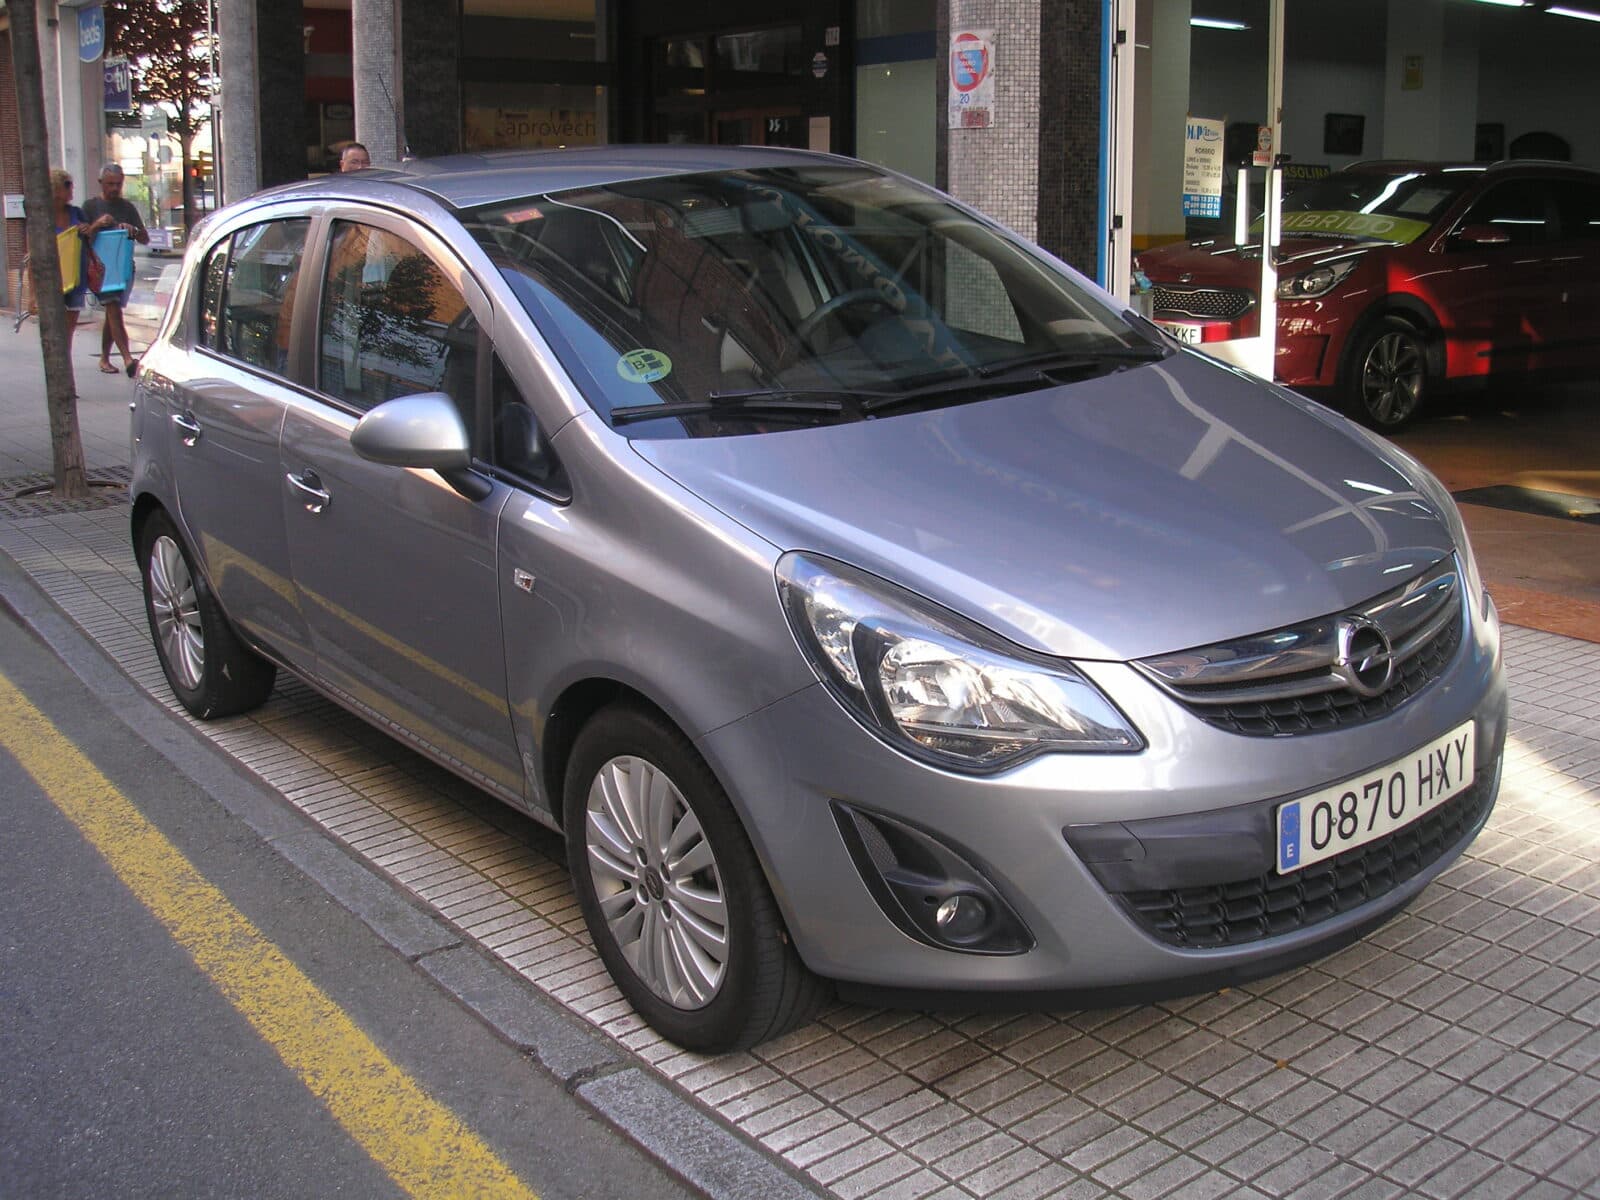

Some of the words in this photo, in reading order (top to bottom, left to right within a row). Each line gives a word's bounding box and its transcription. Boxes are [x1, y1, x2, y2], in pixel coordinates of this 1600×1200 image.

[80, 15, 101, 47] beds
[1283, 165, 1329, 180] ASOLINA
[1310, 770, 1406, 851] 0870
[1417, 733, 1468, 806] HXY
[1286, 843, 1295, 858] E
